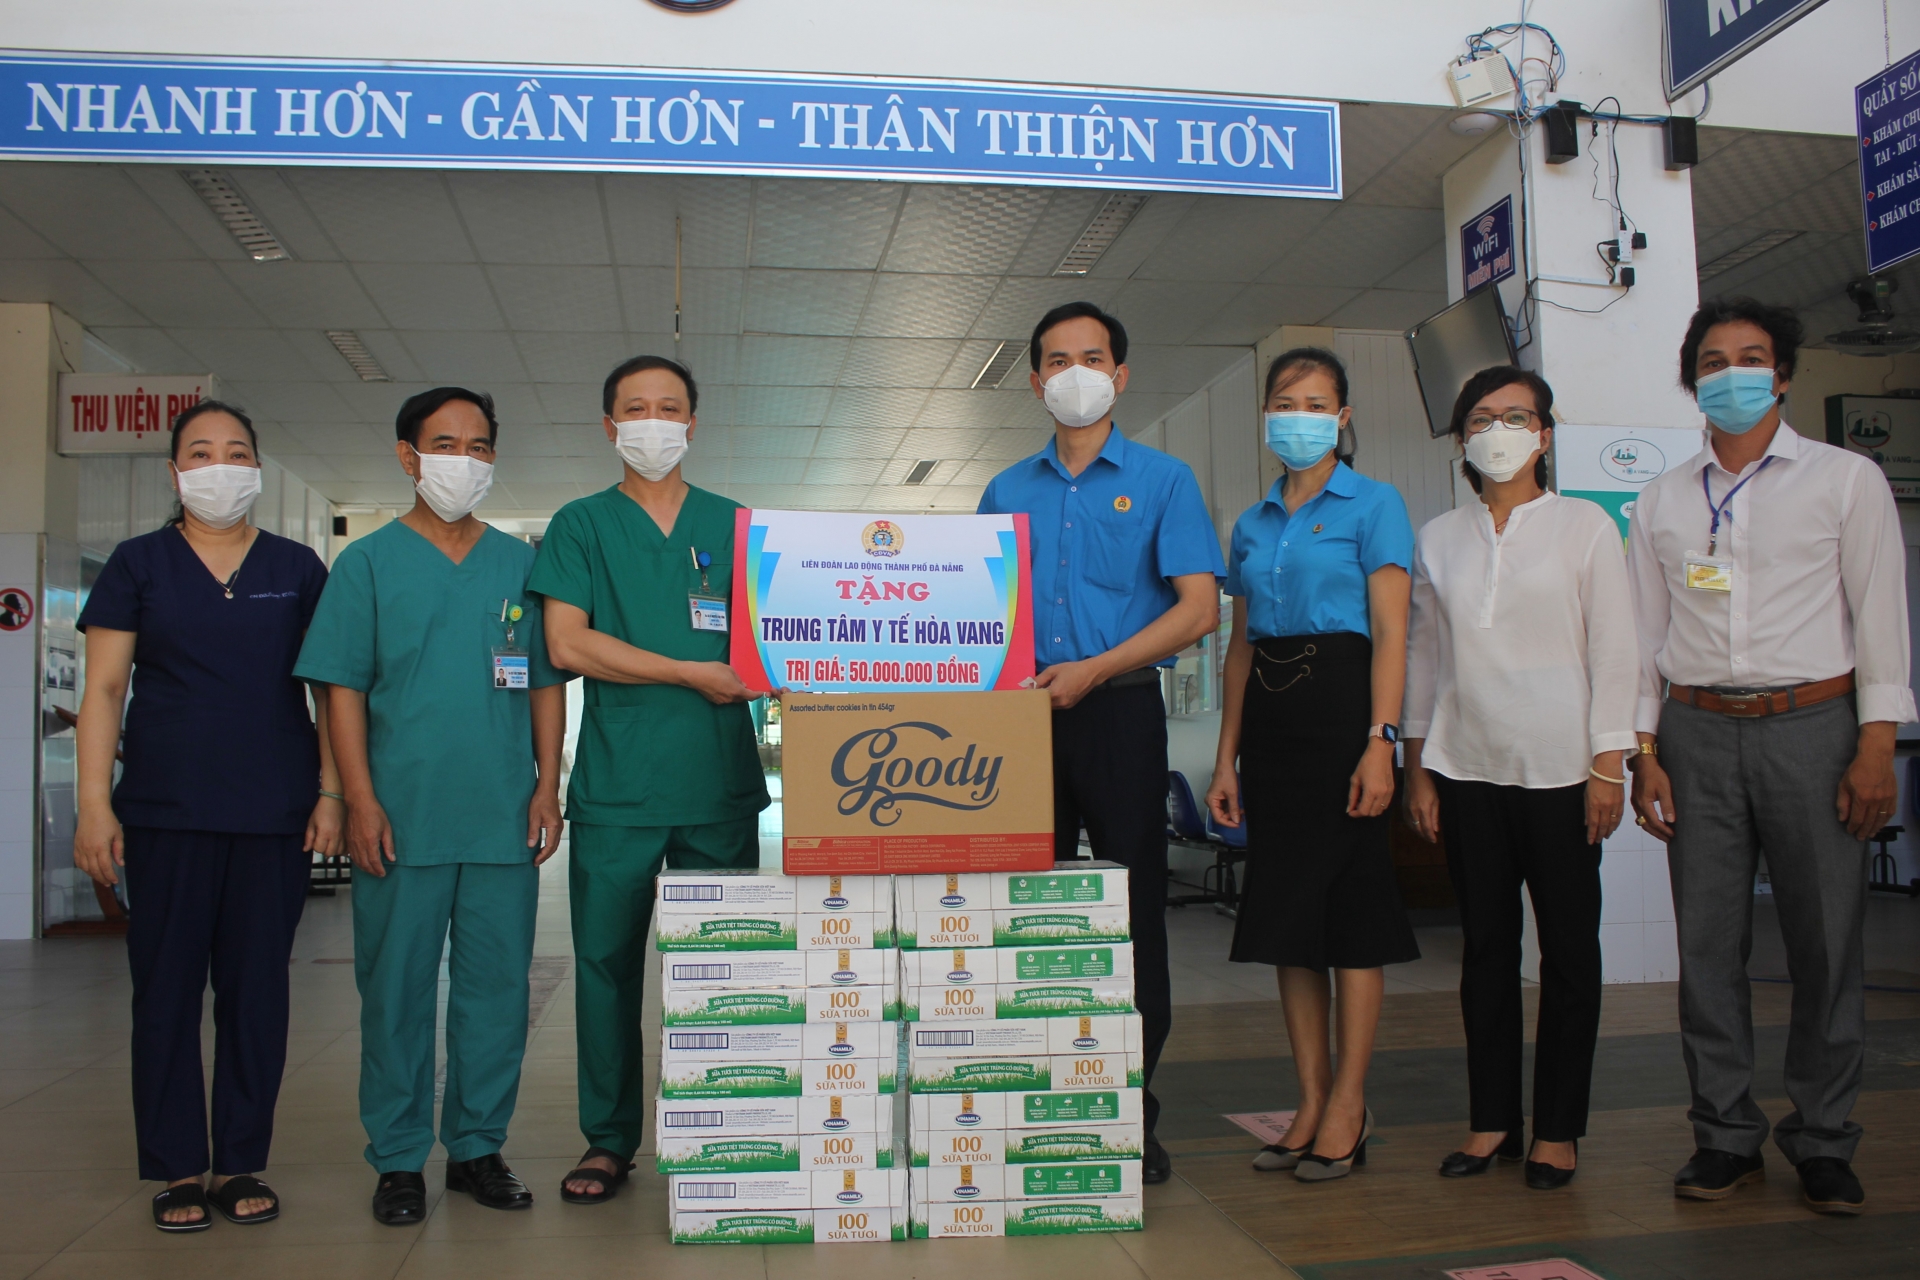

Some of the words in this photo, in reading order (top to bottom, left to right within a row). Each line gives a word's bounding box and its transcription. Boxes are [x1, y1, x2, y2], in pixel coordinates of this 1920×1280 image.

[1863, 77, 1897, 118] QUẦY
[1899, 61, 1917, 96] SỐ
[25, 82, 257, 136] NHANH
[273, 80, 412, 140] HƠN
[461, 78, 592, 144] GẦN
[609, 88, 744, 147] HƠN
[792, 93, 958, 155] THÂN
[977, 104, 1159, 172] THIỆN
[1176, 115, 1298, 171] HƠN
[1873, 118, 1902, 145] KHÁM
[1874, 147, 1891, 167] TAI
[1897, 133, 1918, 156] MŨI
[1876, 173, 1906, 198] KHÁM
[1906, 161, 1920, 184] SẢ
[1879, 204, 1908, 229] KHÁM
[1473, 232, 1499, 261] WiFi
[71, 394, 109, 433] THU
[114, 386, 160, 439] VIỆN
[801, 560, 819, 569] LIÊN
[821, 560, 843, 569] ĐOÀN
[844, 562, 859, 570] LAO
[861, 560, 882, 571] ĐỘNG
[884, 562, 910, 571] THÀNH
[911, 562, 927, 572] PHỐ
[929, 562, 940, 572] ĐÀ
[836, 575, 930, 606] TẶNG
[761, 617, 821, 642] TRUNG
[827, 614, 866, 643] TÂM
[872, 620, 884, 643] Y
[889, 612, 911, 643] TẾ
[915, 616, 950, 645] HÒA
[956, 621, 1004, 645] VANG
[786, 660, 810, 686] TRỊ
[814, 656, 845, 682] GIÁ:
[849, 661, 932, 684] 50.000.000
[937, 658, 979, 684] ĐỒNG
[789, 704, 816, 712] Assorted
[869, 703, 877, 711] tin
[878, 703, 895, 712] 454gr
[831, 721, 1004, 827] Goody
[811, 935, 831, 946] SỮA
[834, 935, 861, 945] TƯƠI
[930, 933, 950, 943] SỮA
[953, 932, 979, 942] TƯƠI
[820, 1010, 840, 1018] SỮA
[843, 1008, 870, 1018] TƯƠI
[934, 1006, 955, 1016] SỮA
[958, 1006, 984, 1015] TƯƠI
[816, 1080, 836, 1090] SỮA
[839, 1080, 866, 1089] TƯƠI
[1064, 1076, 1085, 1086] SỮA
[1088, 1075, 1114, 1084] TƯƠI
[813, 1154, 834, 1165] SỮA
[837, 1154, 863, 1164] TƯƠI
[942, 1154, 962, 1163] SỮA
[966, 1153, 992, 1162] TƯƠI
[828, 1230, 848, 1239] SỮA
[851, 1229, 878, 1238] TƯƠI
[944, 1224, 964, 1234] SỮA
[966, 1224, 993, 1233] TƯƠI
